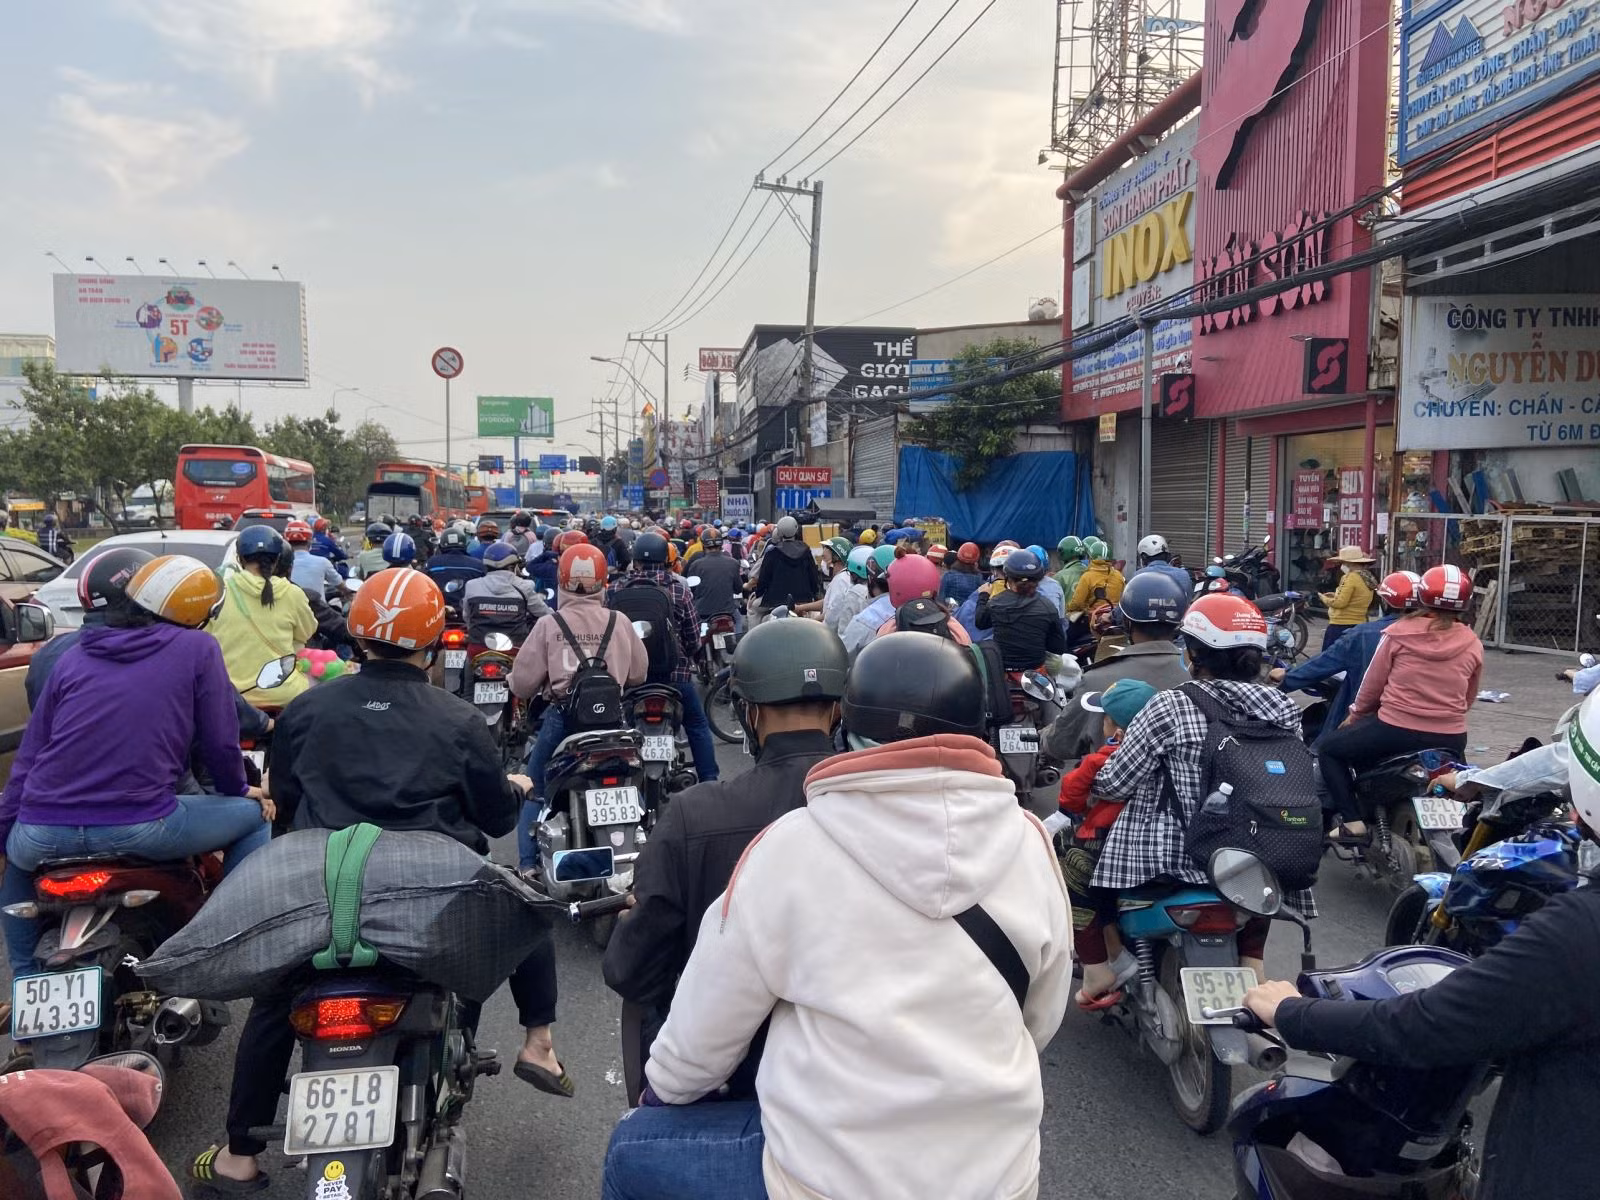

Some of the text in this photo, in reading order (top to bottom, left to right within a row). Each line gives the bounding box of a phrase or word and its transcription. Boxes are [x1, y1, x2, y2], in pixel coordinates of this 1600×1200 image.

[1472, 52, 1505, 83] CÔNG
[1156, 157, 1191, 202] PHÁT
[1104, 191, 1194, 299] INOX
[1447, 303, 1507, 329] CÔNG
[1514, 307, 1541, 328] TY
[170, 319, 189, 336] 5T
[873, 336, 916, 357] THẾ
[1447, 332, 1568, 384] NGUYỄN
[1508, 391, 1563, 416] CHẤN
[1527, 420, 1553, 441] TỪ
[1558, 424, 1583, 440] 6M
[779, 469, 829, 482] CHÚ Ý QUAN SÁT
[1148, 598, 1177, 607] FILA
[645, 737, 668, 747] 6-B4
[643, 748, 671, 759] 46.26
[591, 805, 637, 823] 395.83
[1421, 813, 1462, 827] 850.6
[1470, 858, 1509, 868] TFX
[26, 973, 85, 1005] 50-Y1
[1193, 972, 1246, 994] 95-P1
[17, 1000, 95, 1033] 443.39
[329, 1045, 363, 1053] HONDA
[306, 1073, 381, 1110] 66-L8
[302, 1109, 376, 1145] 2781
[323, 1185, 342, 1194] PAY
